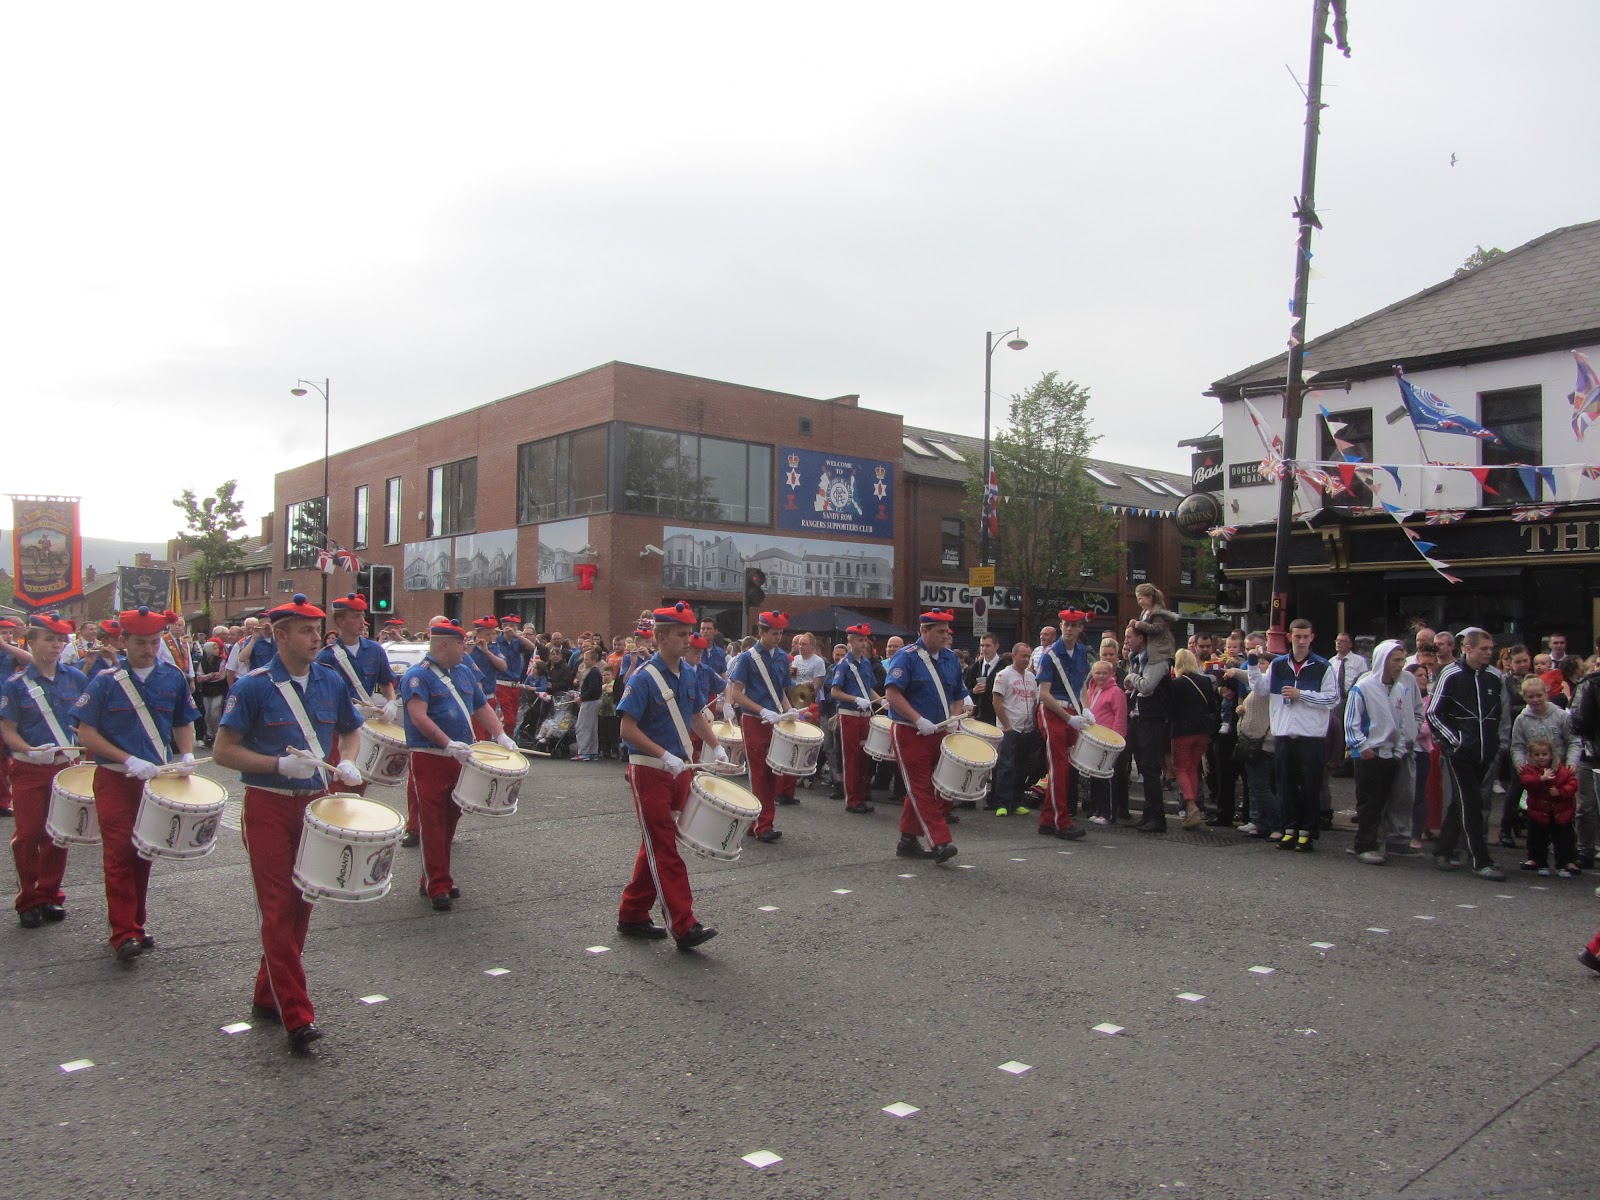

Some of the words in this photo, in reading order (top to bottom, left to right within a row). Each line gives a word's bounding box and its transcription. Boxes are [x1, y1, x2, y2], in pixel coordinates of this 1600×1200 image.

[826, 460, 852, 469] WELCOME
[1231, 465, 1257, 476] DONEG
[1193, 464, 1224, 485] Bass
[1241, 474, 1262, 484] ROAD
[823, 511, 840, 521] SANDY
[841, 514, 853, 522] ROW
[801, 519, 826, 529] RANGERS
[827, 522, 858, 532] SUPPORTERS
[859, 525, 873, 533] CLUB
[1520, 521, 1600, 553] TH
[921, 585, 956, 603] JUST
[958, 587, 1003, 606] GTS
[1273, 599, 1280, 607] 6
[165, 818, 180, 848] ANDANTE
[335, 850, 351, 888] ANDANTE
